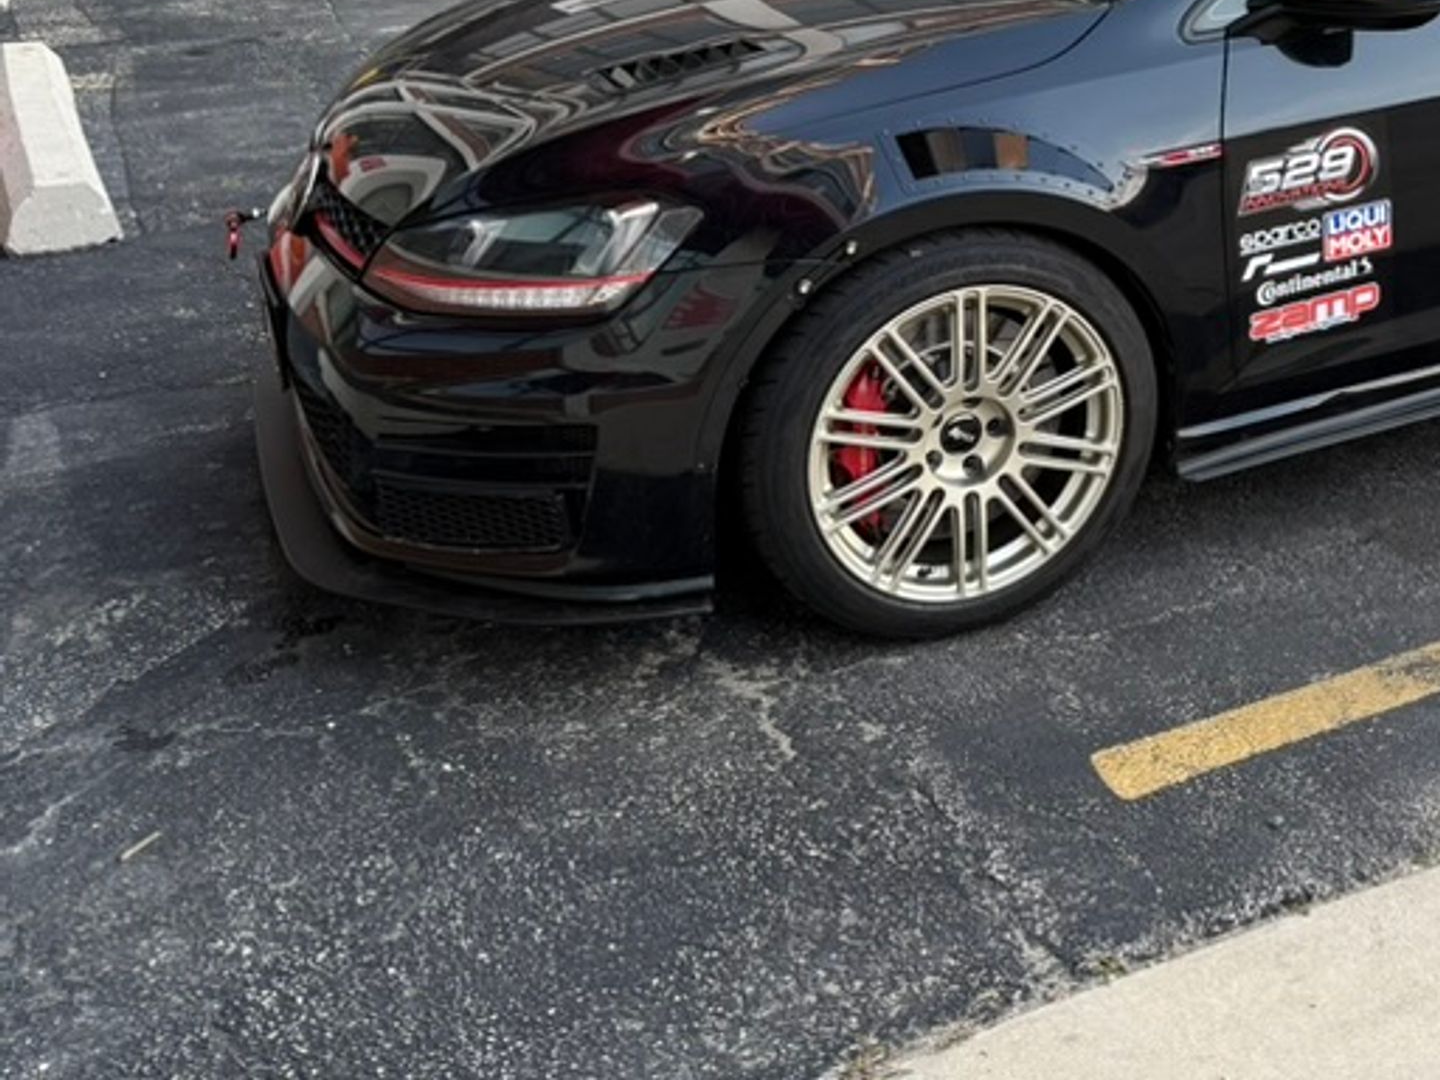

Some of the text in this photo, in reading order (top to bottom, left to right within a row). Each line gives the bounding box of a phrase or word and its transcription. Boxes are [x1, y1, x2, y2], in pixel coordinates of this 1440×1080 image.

[1329, 204, 1386, 235] LIQUI
[1330, 228, 1388, 257] MOLY
[1256, 261, 1359, 306] Continental
